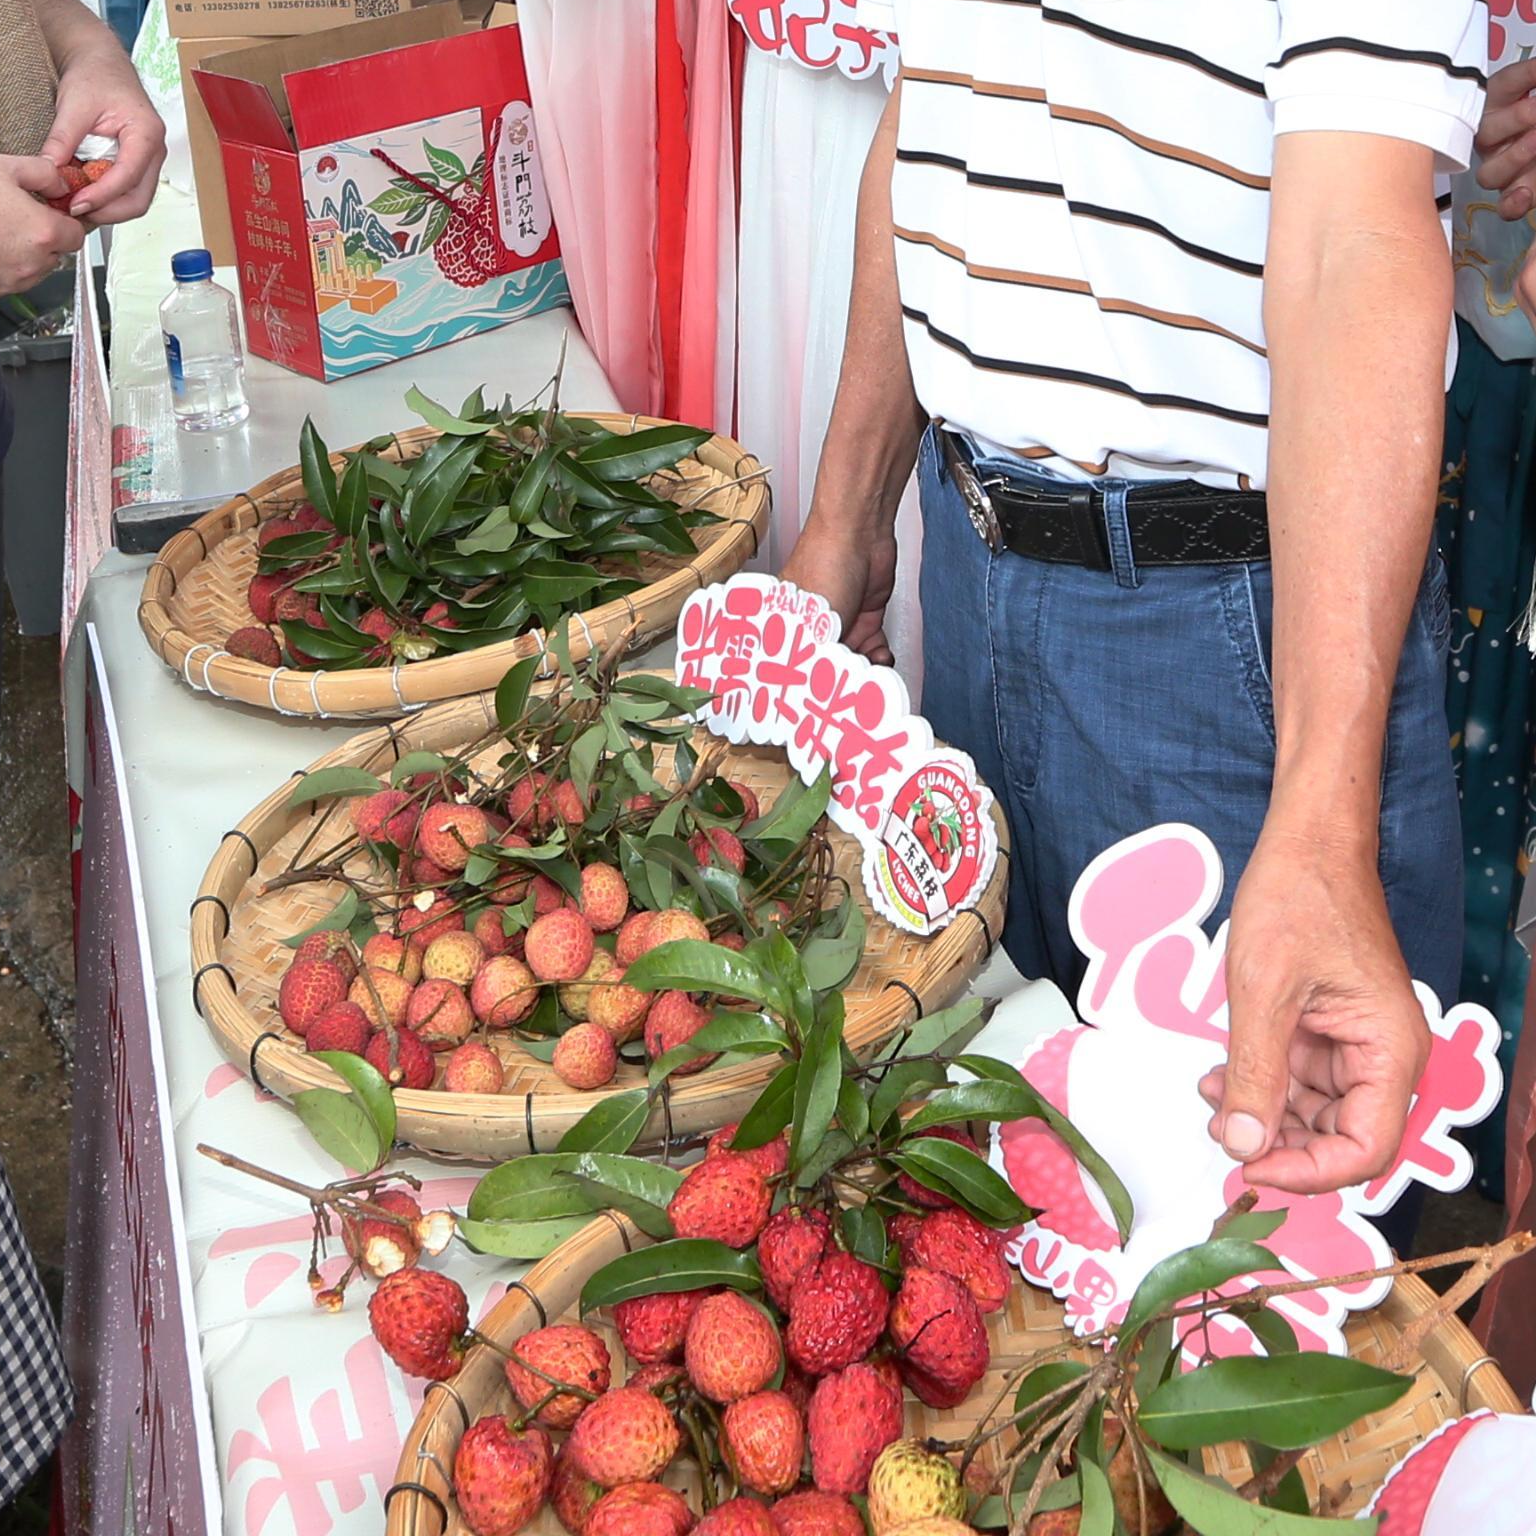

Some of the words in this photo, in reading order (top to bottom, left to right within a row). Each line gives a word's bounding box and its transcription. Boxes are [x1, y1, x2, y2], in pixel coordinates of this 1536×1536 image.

[681, 588, 908, 830] 糯米糍
[917, 772, 977, 858] GUANGDONG
[892, 858, 921, 904] LYCHEE
[894, 831, 939, 901] 广东荔枝
